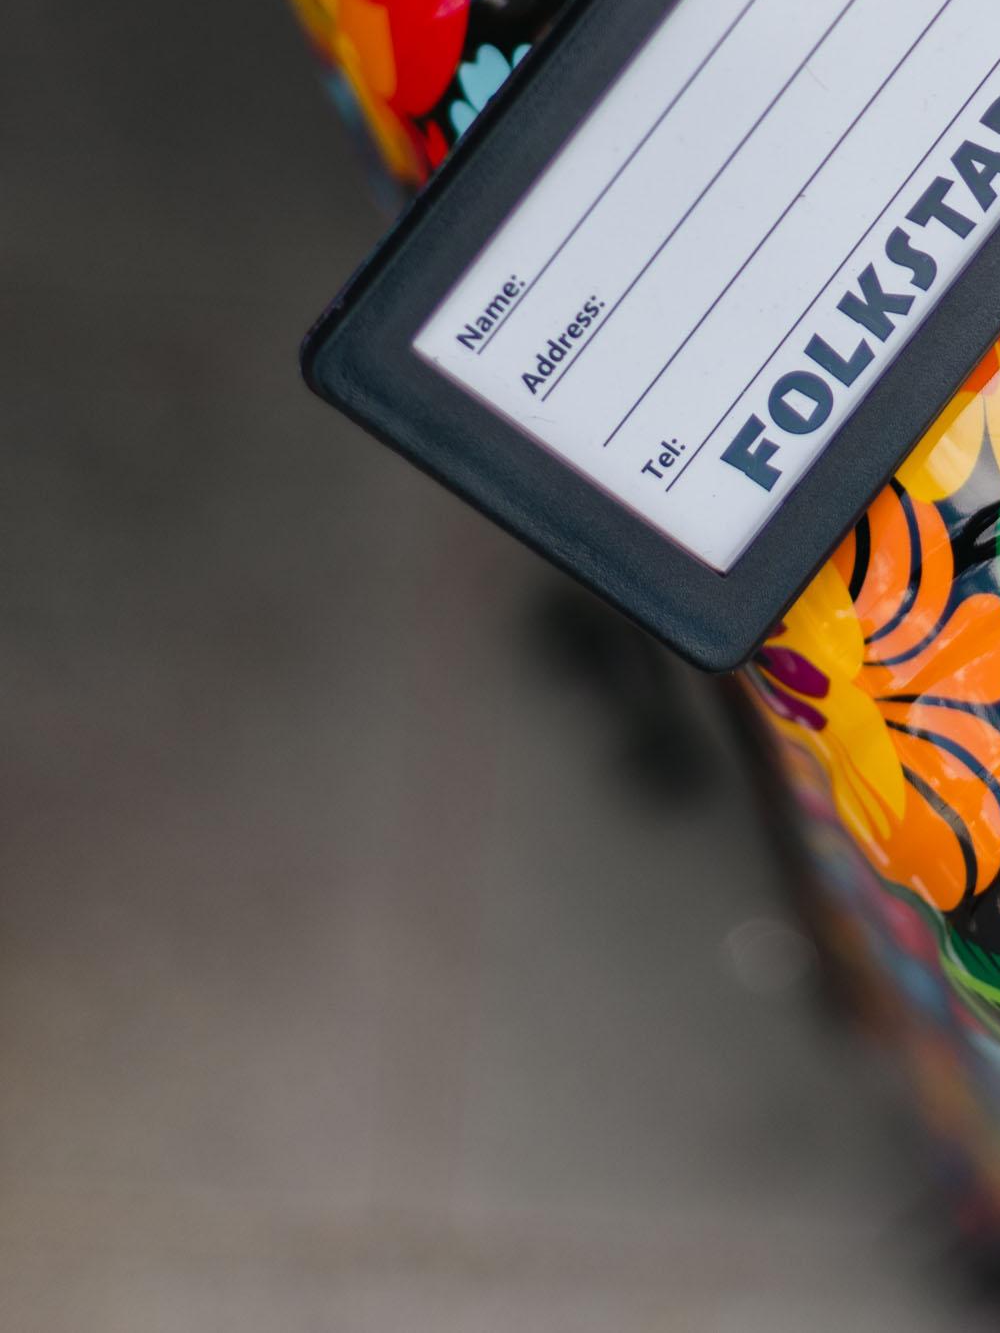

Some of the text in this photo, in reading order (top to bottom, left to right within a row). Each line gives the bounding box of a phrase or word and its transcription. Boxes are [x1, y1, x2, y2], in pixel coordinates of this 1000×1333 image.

[456, 273, 525, 351] Name:
[521, 295, 606, 396] Address:
[641, 436, 686, 481] Tel:
